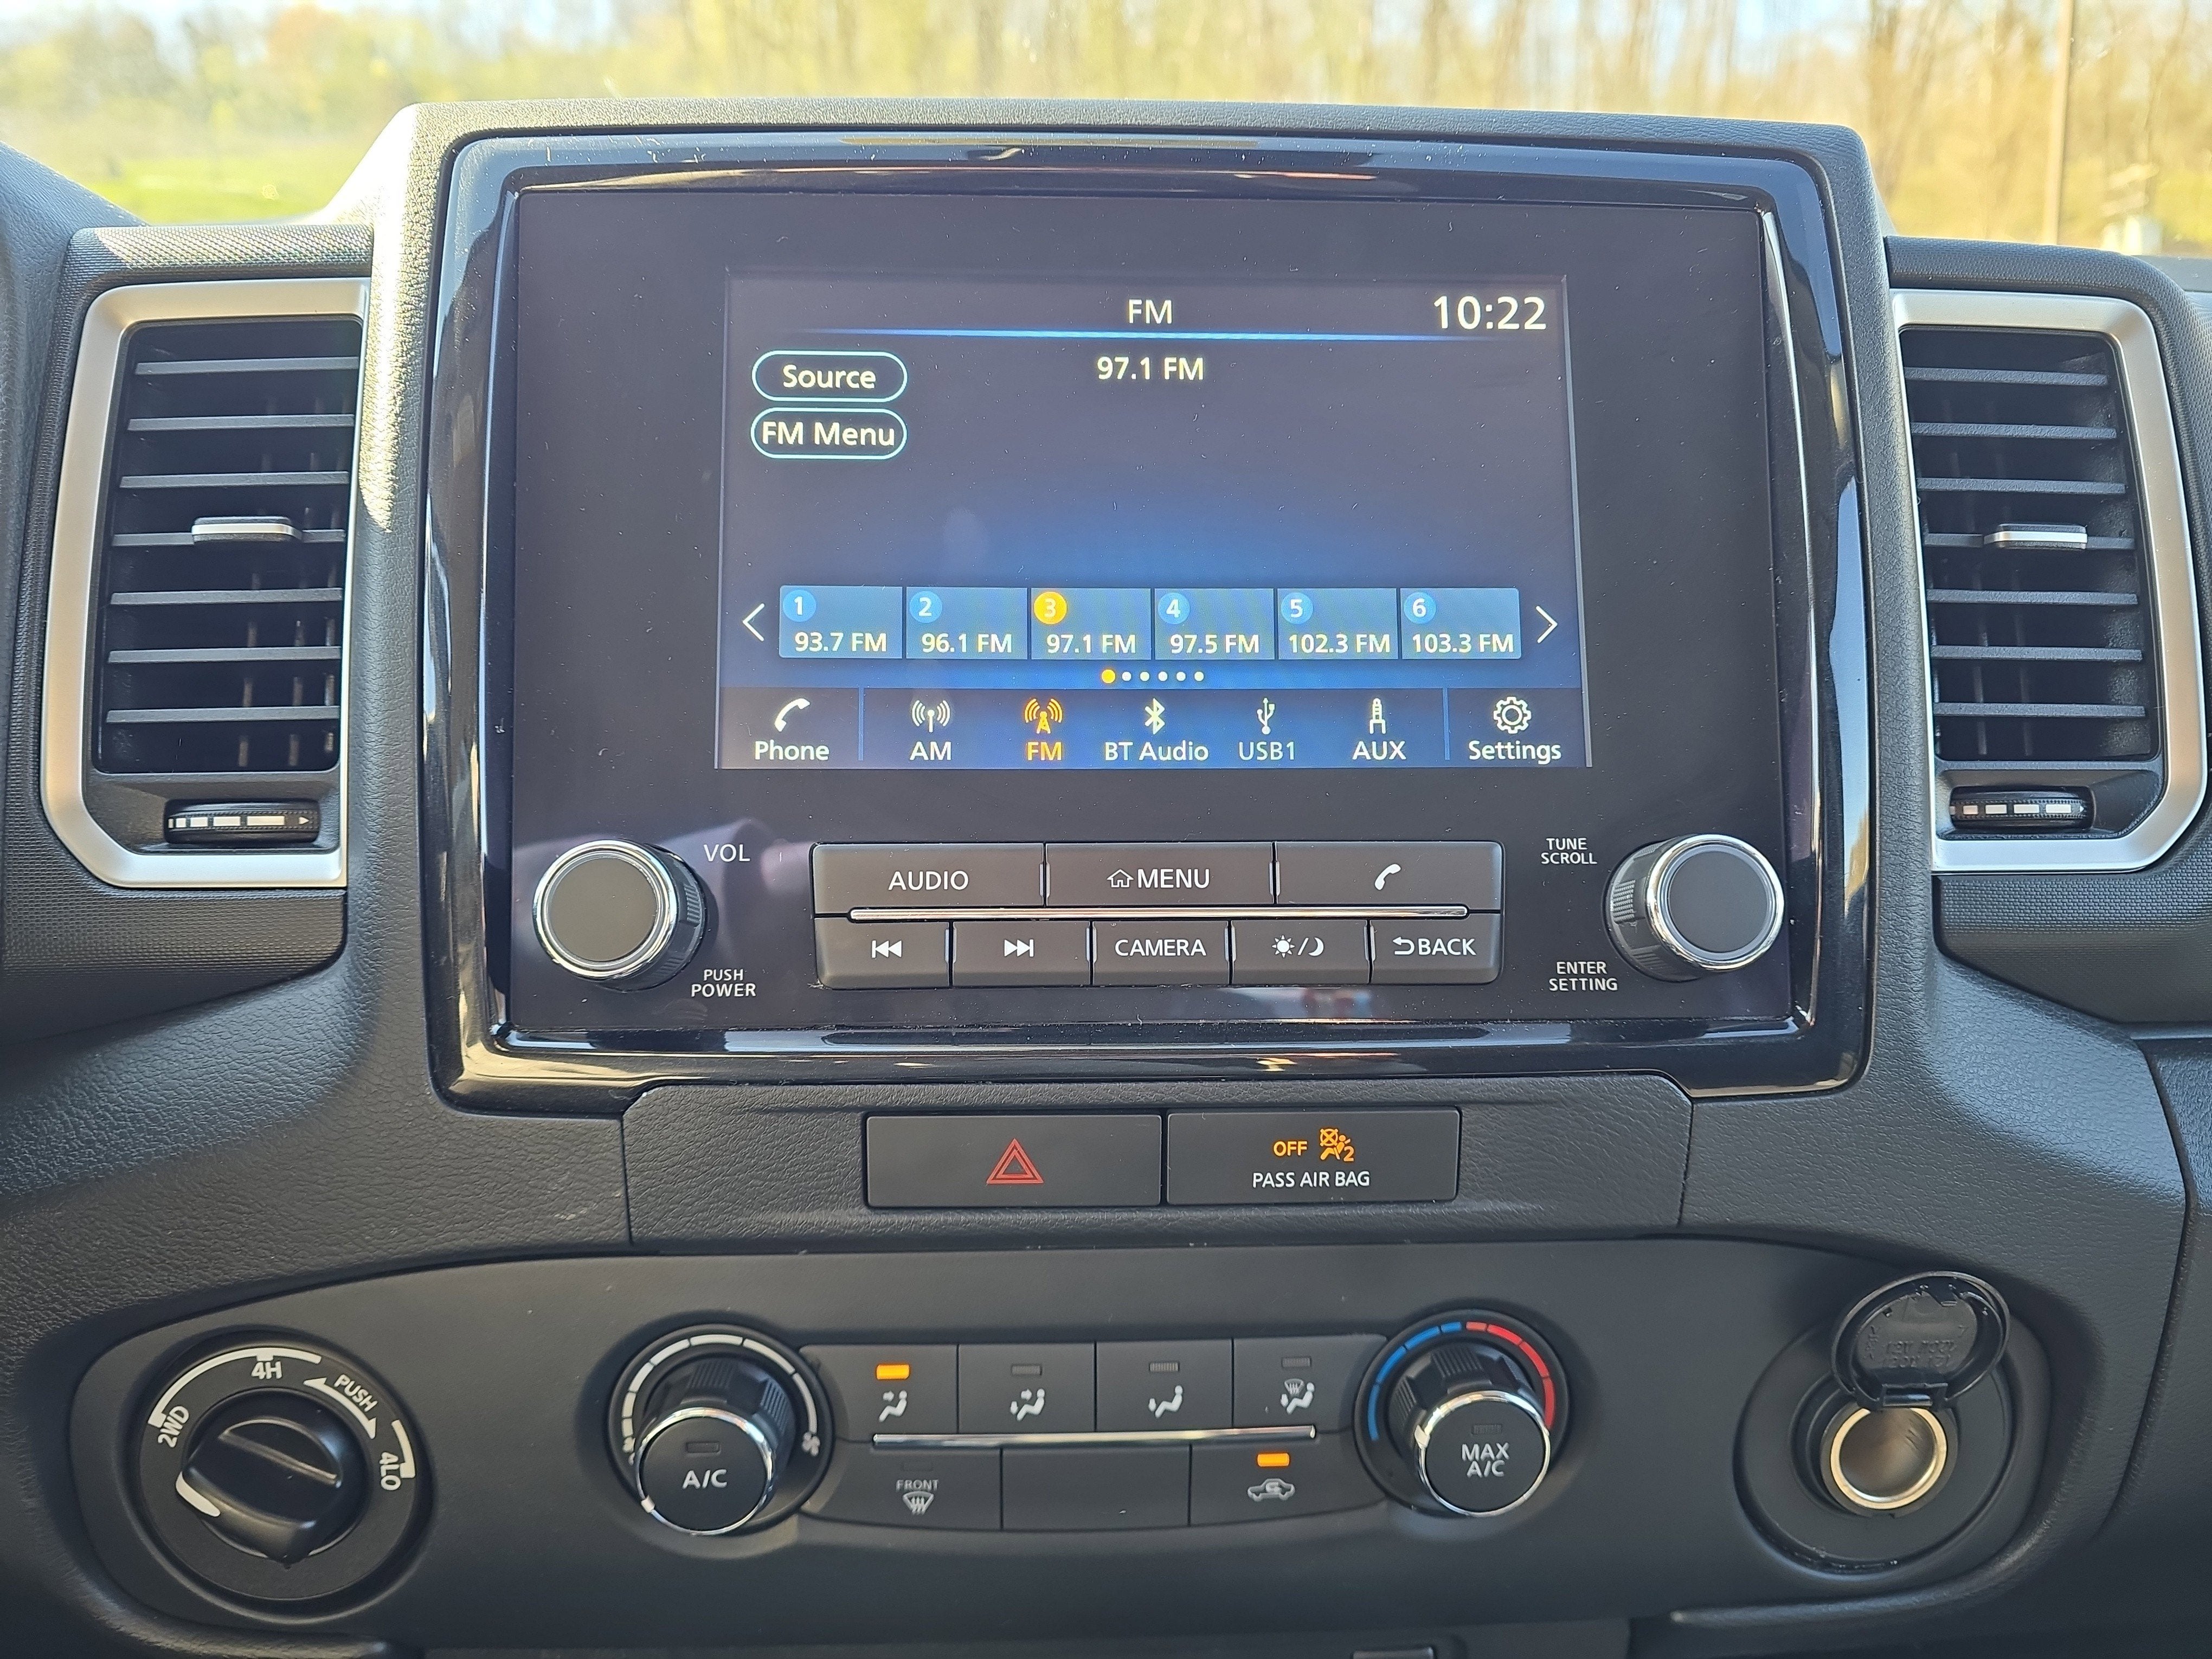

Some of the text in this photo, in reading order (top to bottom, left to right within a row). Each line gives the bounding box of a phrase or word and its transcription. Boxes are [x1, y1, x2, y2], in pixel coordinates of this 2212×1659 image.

[1128, 299, 1172, 324] FM
[1433, 296, 1547, 330] 10:22
[783, 364, 876, 389] Source
[1097, 356, 1204, 381] 97.1 FM
[762, 421, 895, 446] FM Menu
[794, 597, 802, 615] 1
[918, 599, 931, 616] 2
[1044, 600, 1056, 617] 3
[1167, 600, 1180, 617] 4
[1290, 600, 1303, 617] 5
[1413, 599, 1426, 616] 6
[795, 633, 887, 652] 93.7 FM
[922, 634, 1012, 653] 96.1 FM
[1046, 635, 1136, 653] 97.1 FM
[1171, 634, 1259, 654] 97.5 FM
[1289, 634, 1390, 653] 102.3 FM
[1412, 633, 1514, 653] 103.3 FM
[755, 741, 829, 762] Phone
[910, 742, 951, 761] AM
[1027, 742, 1062, 761] FM
[1105, 741, 1208, 761] BT Audio
[1238, 742, 1296, 760] USB1
[1353, 741, 1406, 760] AUX
[1469, 741, 1561, 766] Settings
[703, 844, 751, 862] VOL
[1546, 838, 1587, 850] TUNE
[1541, 852, 1597, 864] SCROLL
[888, 871, 969, 891] AUDIO
[1137, 869, 1210, 889] MENU
[1114, 938, 1206, 957] CAMERA
[1418, 937, 1476, 956] BACK
[703, 968, 743, 981] PUSH
[1556, 961, 1607, 974] ENTER
[691, 983, 756, 998] POWER
[1549, 978, 1618, 991] SETTING
[1274, 1141, 1307, 1156] OFF
[1252, 1171, 1370, 1188] PASS AIR BAG
[252, 1361, 282, 1380] 4H
[335, 1374, 377, 1411] PUSH
[158, 1406, 189, 1448] 2WD
[1461, 1443, 1509, 1462] MAX
[380, 1451, 401, 1490] 4LO
[682, 1469, 728, 1489] A/C
[1467, 1461, 1504, 1478] A/C
[896, 1479, 938, 1490] FRONT
